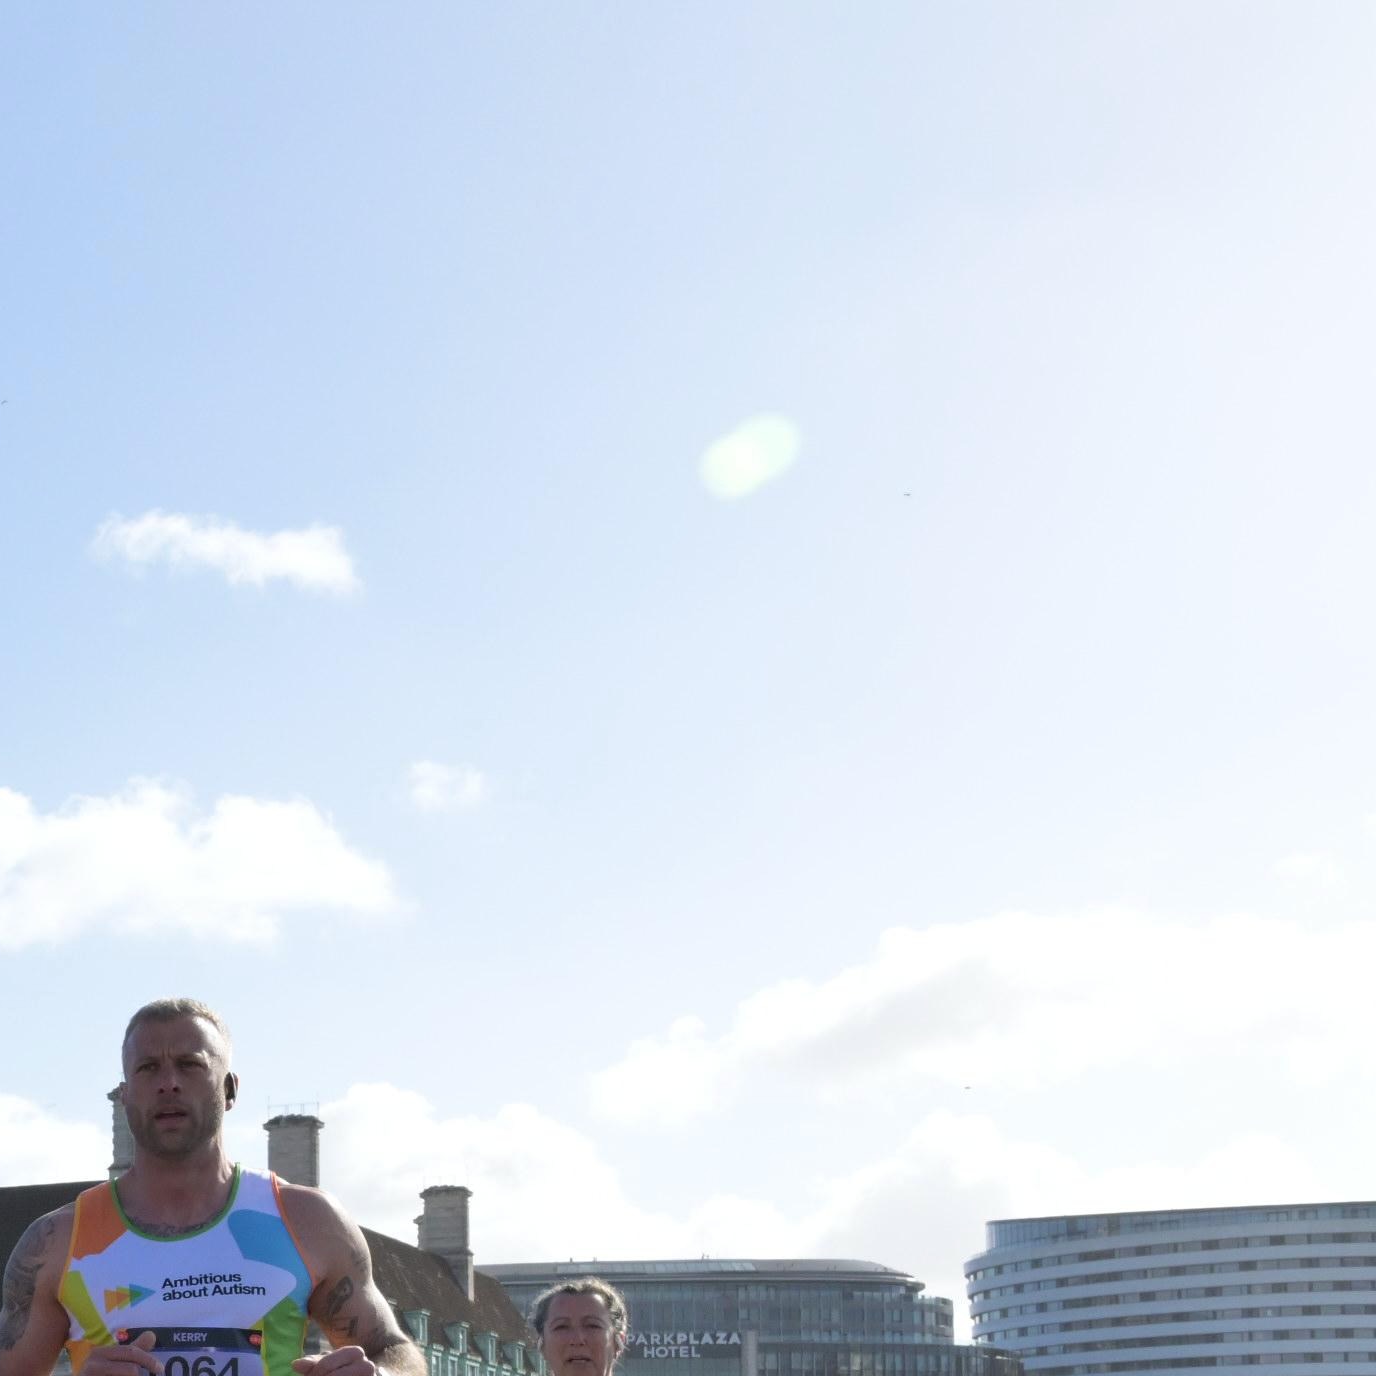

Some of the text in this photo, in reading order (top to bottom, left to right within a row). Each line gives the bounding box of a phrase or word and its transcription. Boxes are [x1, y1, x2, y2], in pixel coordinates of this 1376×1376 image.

[162, 1273, 241, 1289] Ambitious
[162, 1283, 266, 1301] about Autism
[173, 1333, 208, 1342] KERRY
[644, 1346, 701, 1358] HOTEL
